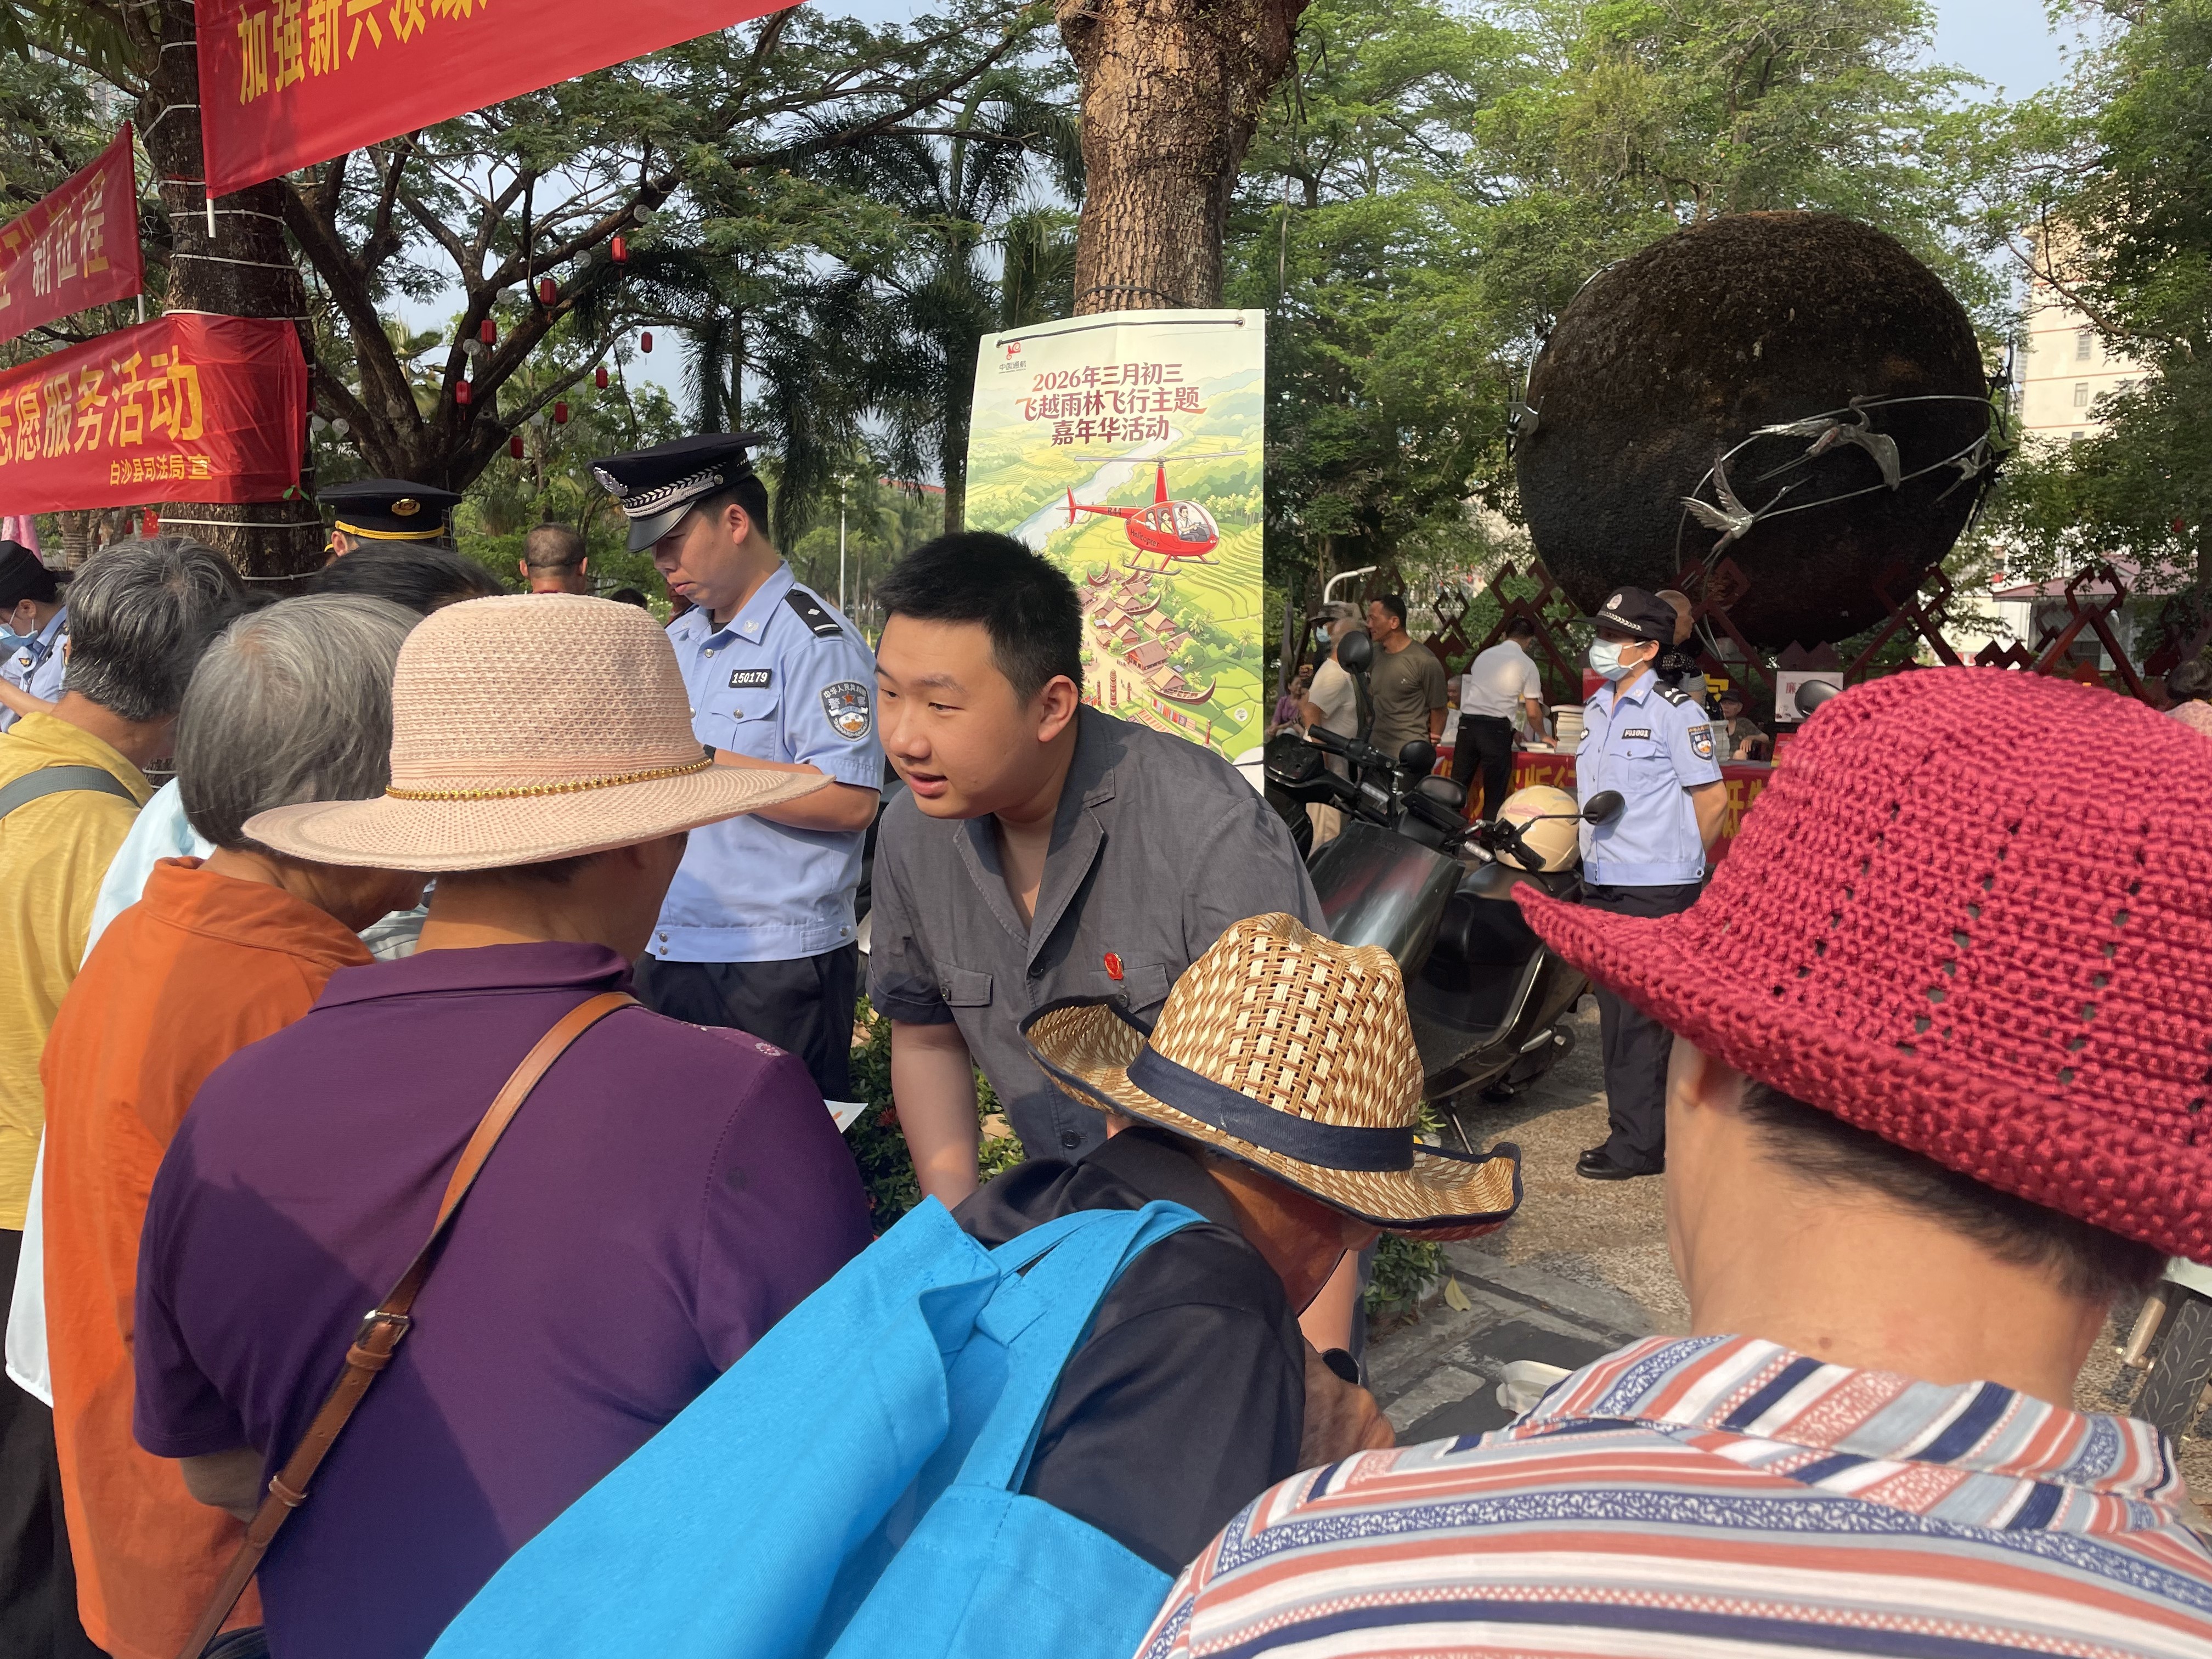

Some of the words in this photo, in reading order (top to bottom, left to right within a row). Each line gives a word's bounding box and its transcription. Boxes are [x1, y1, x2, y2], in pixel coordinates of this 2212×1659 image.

[238, 0, 490, 106] 加强新兴
[1031, 362, 1184, 392] 2026年三月初三
[1015, 386, 1208, 421] 飞越雨林飞行主题
[1051, 415, 1169, 448] 嘉年华活动
[1108, 507, 1121, 516] R44
[1130, 528, 1160, 548] Helicopter
[732, 672, 768, 684] 150179
